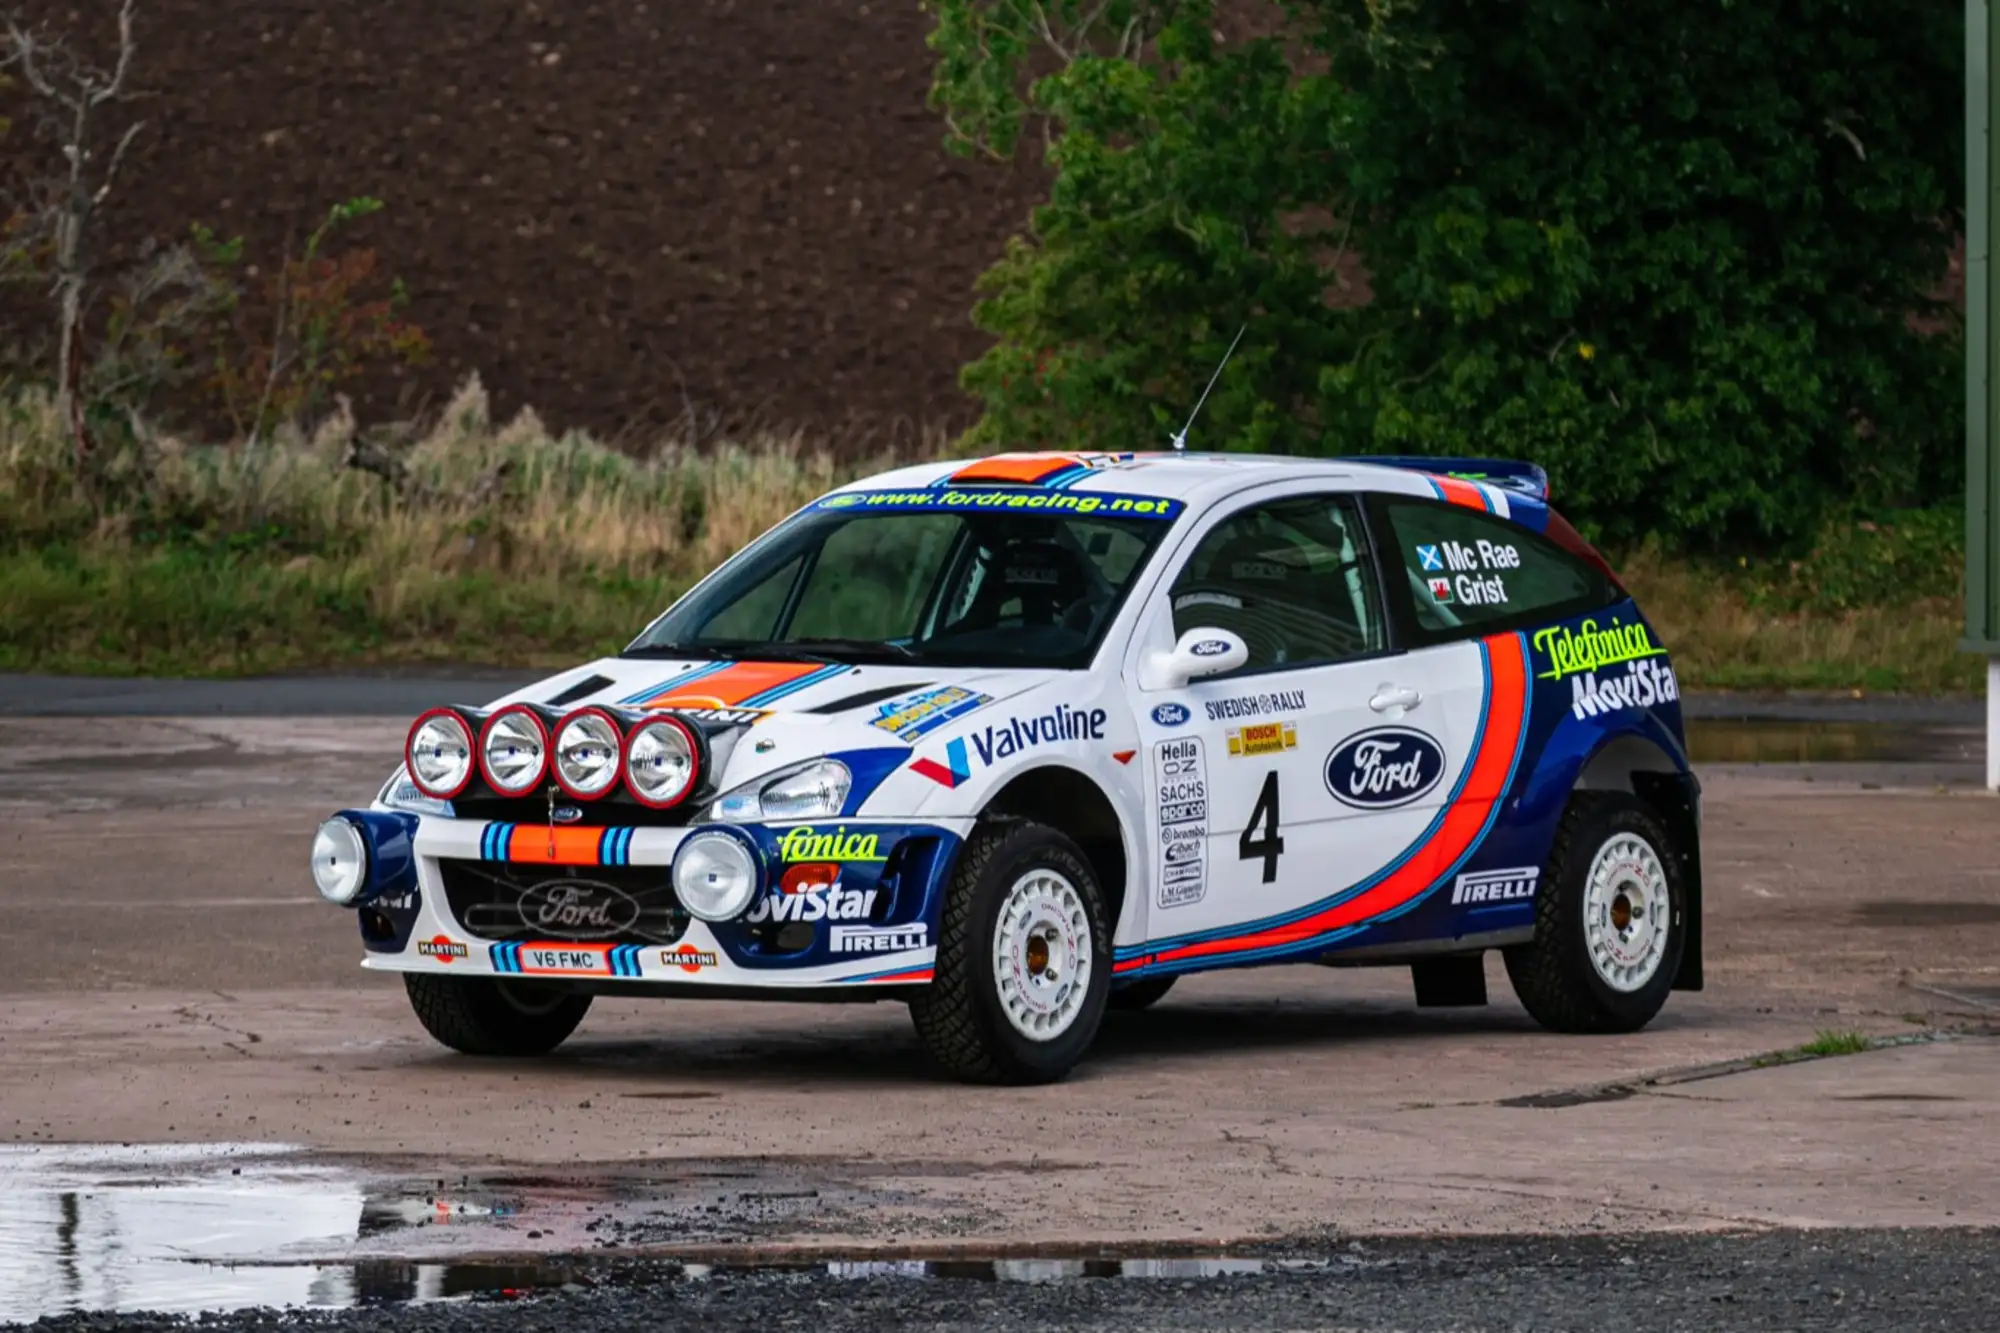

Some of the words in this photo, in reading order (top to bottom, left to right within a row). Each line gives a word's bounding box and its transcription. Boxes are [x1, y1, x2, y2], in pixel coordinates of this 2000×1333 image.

[865, 490, 1171, 515] www.fordracing.net
[1442, 541, 1478, 571] Mc
[1476, 539, 1521, 569] Rae
[1456, 574, 1509, 606] Grist
[1195, 640, 1225, 655] Ford
[1571, 657, 1681, 720] MoviSta
[1157, 703, 1183, 724] Ford
[1205, 696, 1261, 721] SWEDISH
[1270, 690, 1307, 712] RALLY
[971, 702, 1107, 768] Valvoline
[1245, 725, 1277, 741] BOSCH
[1161, 741, 1197, 760] Hella
[1349, 739, 1422, 796] Ford
[1160, 780, 1205, 803] SACHS
[1239, 770, 1285, 884] 4
[1451, 865, 1540, 904] PIRELLI
[538, 885, 612, 927] Ford
[418, 941, 467, 957] MARTINI
[829, 922, 929, 952] PIRELLI
[534, 951, 556, 968] V6
[560, 951, 594, 969] FMC
[662, 951, 717, 967] MARTINI
